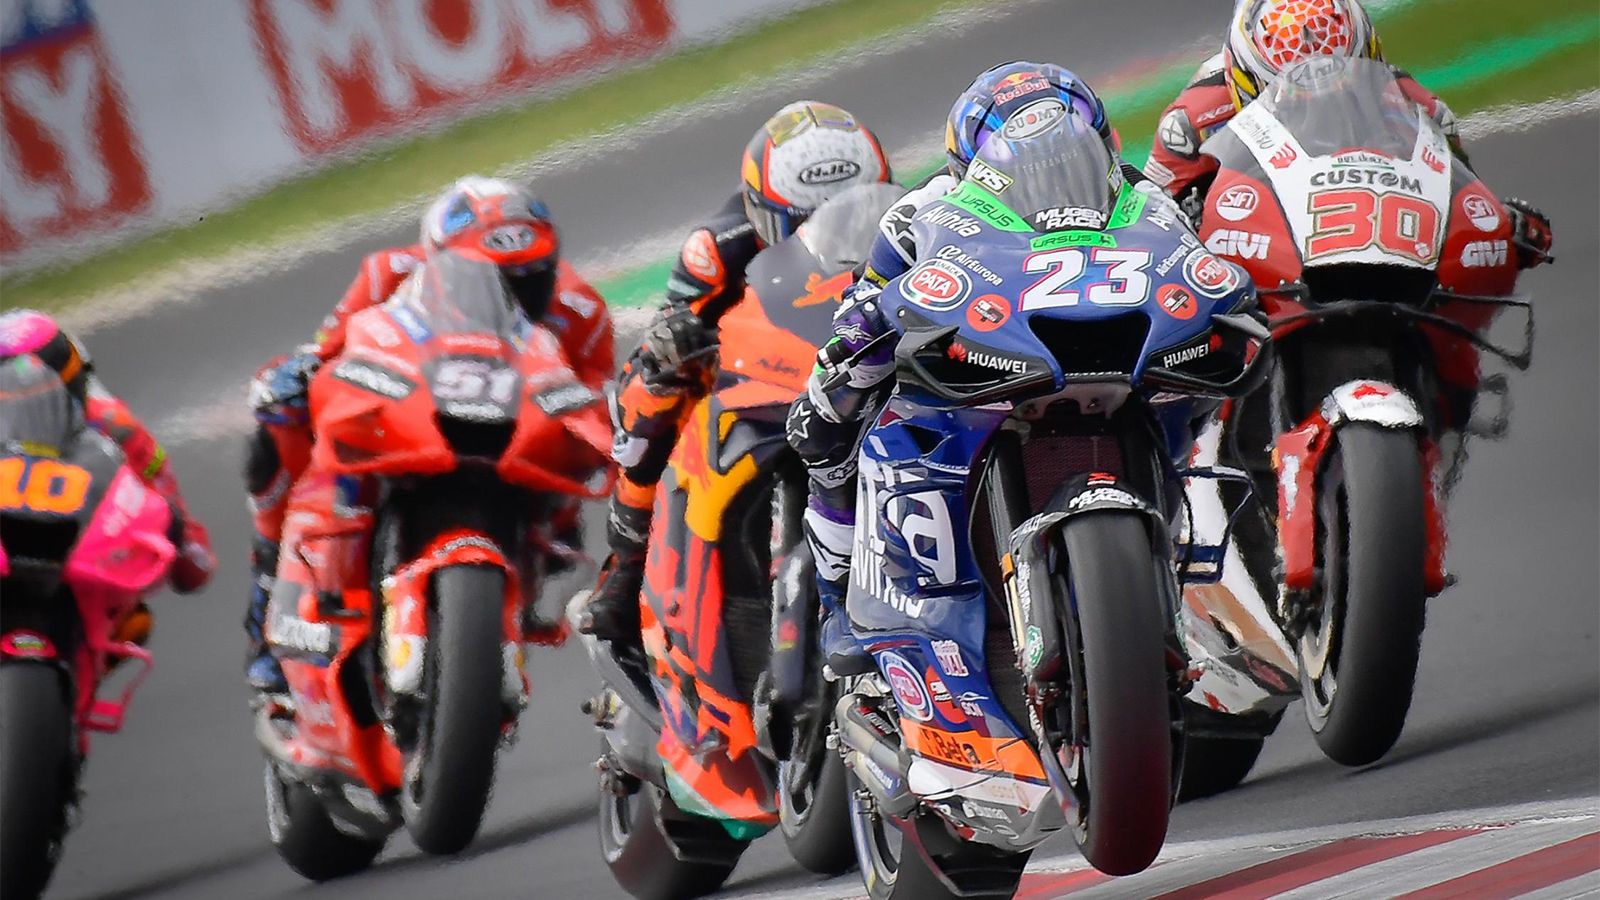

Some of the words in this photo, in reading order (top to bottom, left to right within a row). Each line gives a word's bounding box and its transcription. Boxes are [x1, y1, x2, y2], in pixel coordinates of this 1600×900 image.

[276, 0, 632, 136] MOL
[1310, 167, 1422, 195] CUSTOM
[960, 194, 1015, 228] URSUS
[1035, 206, 1108, 224] MUGEN
[1045, 215, 1102, 230] RACE
[1305, 187, 1442, 265] 30
[1032, 234, 1093, 249] URSUS
[1204, 228, 1271, 260] GIVI
[1460, 240, 1508, 268] GIVI
[912, 269, 955, 298] PATA
[1017, 246, 1152, 312] 23
[966, 350, 1027, 375] HUAWEI
[1163, 342, 1210, 369] HUAWEI
